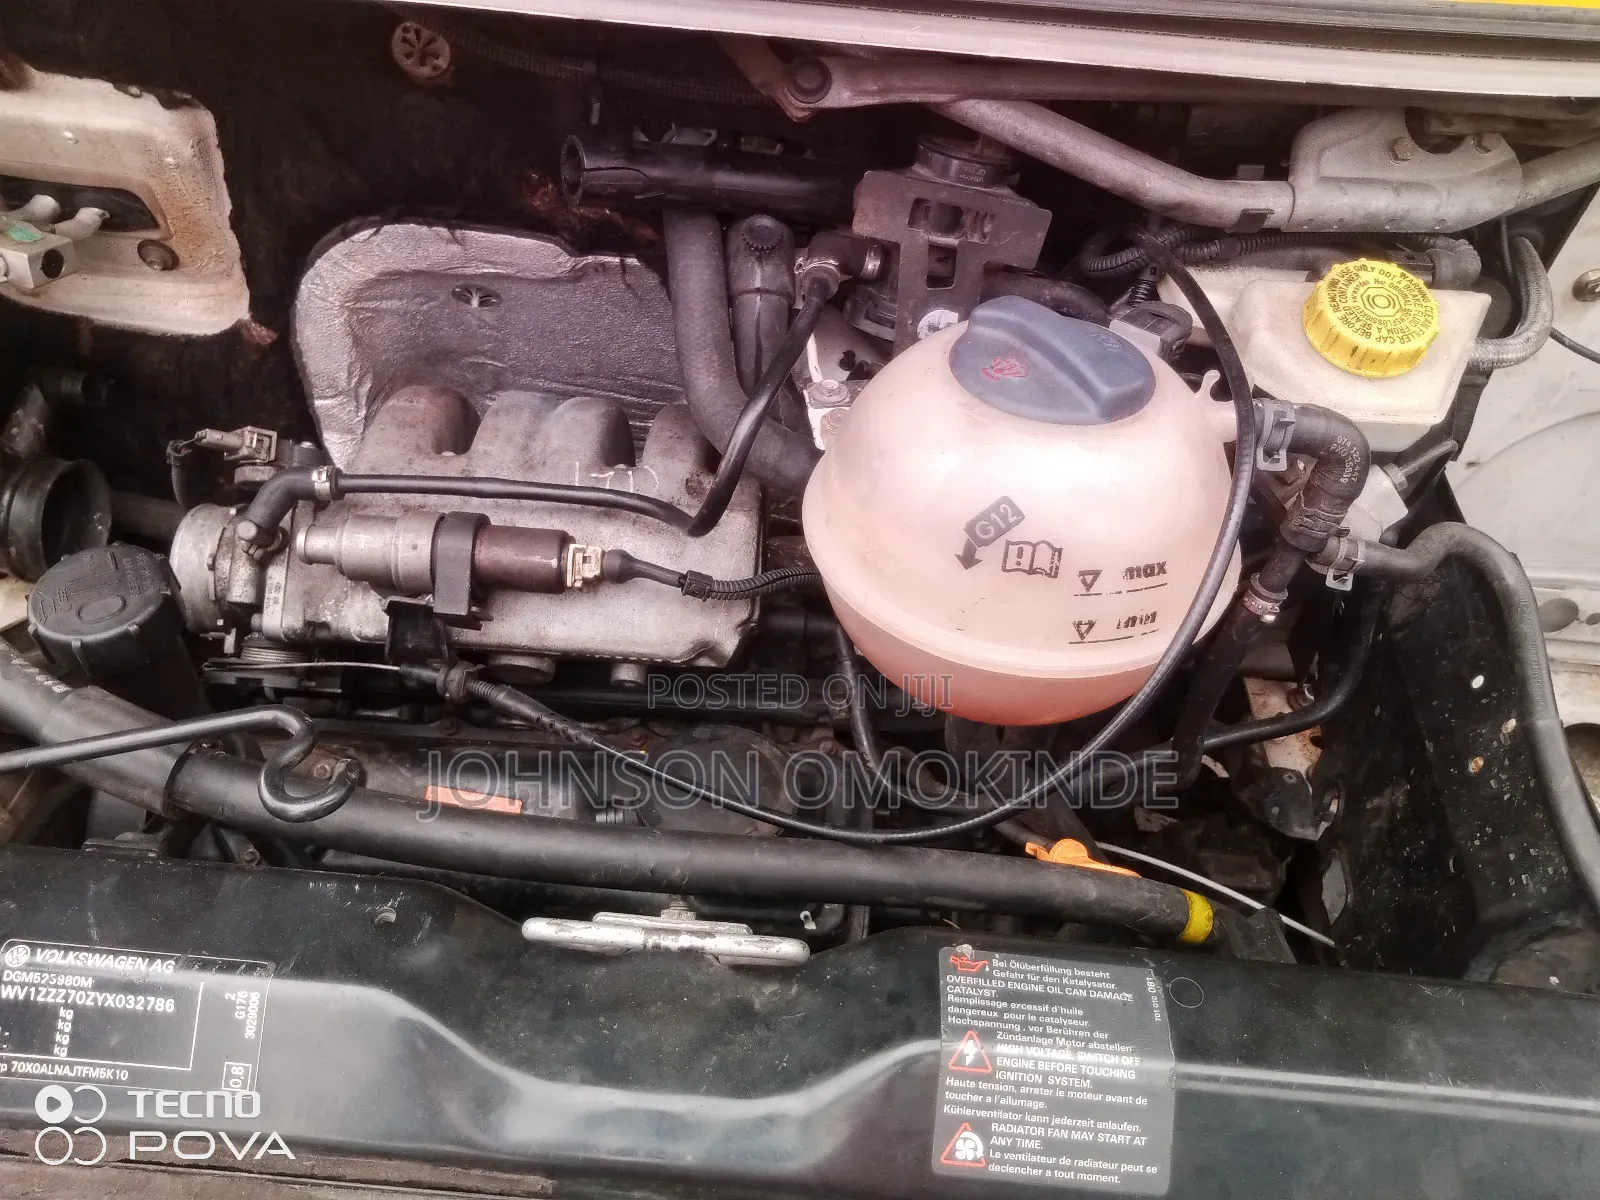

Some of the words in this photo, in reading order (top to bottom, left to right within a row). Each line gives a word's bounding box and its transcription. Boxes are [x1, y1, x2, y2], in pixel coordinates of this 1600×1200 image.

[1336, 266, 1353, 278] USE
[1378, 269, 1397, 281] DOT
[1399, 271, 1431, 303] WARNING
[1402, 284, 1423, 308] BRAKE
[1337, 313, 1372, 339] BEFORE
[1342, 305, 1373, 331] SEALED
[1375, 335, 1396, 344] CAP
[1376, 326, 1383, 334] A
[975, 503, 1022, 539] G12
[1121, 560, 1168, 581] max
[36, 948, 149, 972] VOLKSWAGEN
[149, 958, 176, 974] AG
[992, 959, 1007, 967] Bei
[1010, 960, 1072, 976] Ölüberfüllung
[1074, 968, 1110, 979] besteht
[946, 974, 1005, 988] OVERFILLED
[1007, 981, 1045, 993] ENGINE
[1046, 985, 1064, 994] OIL
[1065, 987, 1087, 997] CAN
[1089, 990, 1134, 1002] DAMAGE
[993, 970, 1024, 980] Gefahr
[1027, 973, 1040, 981] für
[1042, 975, 1060, 984] den
[1062, 976, 1118, 990] Katalysator.
[1, 984, 175, 1013] WV1ZZZ70ZYX032786
[224, 992, 236, 1001] 2
[946, 985, 999, 998] CATALYST.
[59, 1006, 74, 1020] kg
[947, 994, 1008, 1009] Remplissage
[1010, 1002, 1049, 1012] excessif
[1051, 1005, 1084, 1016] d'huile
[57, 1019, 72, 1033] kg
[947, 1005, 999, 1017] dangereux
[1003, 1012, 1026, 1021] pour
[1028, 1013, 1037, 1022] le
[1039, 1016, 1091, 1027] catalyseur.
[55, 1031, 70, 1045] kg
[996, 1031, 1054, 1046] Zündanlage
[1056, 1037, 1086, 1048] Motor
[1028, 1025, 1044, 1033] vor
[1046, 1026, 1090, 1037] Berühren
[1093, 1031, 1109, 1039] der
[53, 1044, 68, 1058] kg
[1120, 1055, 1141, 1066] OFF
[996, 1056, 1036, 1069] ENGINE
[1037, 1061, 1078, 1074] BEFORE
[1080, 1064, 1136, 1080] TOUCHING
[995, 1070, 1043, 1084] IGNITION
[1047, 1075, 1093, 1089] SYSTEM.
[944, 1090, 984, 1102] toucher
[994, 1094, 1047, 1110] l'allumage.
[945, 1076, 976, 1088] Haute
[978, 1081, 1017, 1093] tension,
[1019, 1086, 1053, 1096] arreter
[1056, 1087, 1065, 1097] le
[1067, 1090, 1103, 1101] moteur
[1105, 1094, 1133, 1104] avant
[1135, 1095, 1148, 1105] de
[943, 1103, 1023, 1121] Kühlerventilator
[1024, 1112, 1049, 1123] kann
[1050, 1114, 1095, 1128] jederzeit
[1096, 1120, 1142, 1133] anlaufen.
[989, 1135, 1013, 1147] ANY
[1015, 1138, 1044, 1150] TIME.
[991, 1122, 1045, 1137] RADIATOR
[1047, 1127, 1069, 1139] FAN
[1070, 1130, 1095, 1141] MAY
[1097, 1132, 1132, 1145] START
[1133, 1136, 1148, 1146] AT
[989, 1148, 1001, 1159] Le
[1003, 1152, 1057, 1164] ventilateur
[1059, 1155, 1071, 1166] de
[1073, 1158, 1119, 1170] radiateur
[1120, 1163, 1144, 1173] peut
[1145, 1165, 1158, 1174] se
[988, 1162, 1043, 1176] declencher
[1054, 1169, 1075, 1179] tout
[1076, 1172, 1121, 1184] moment.
